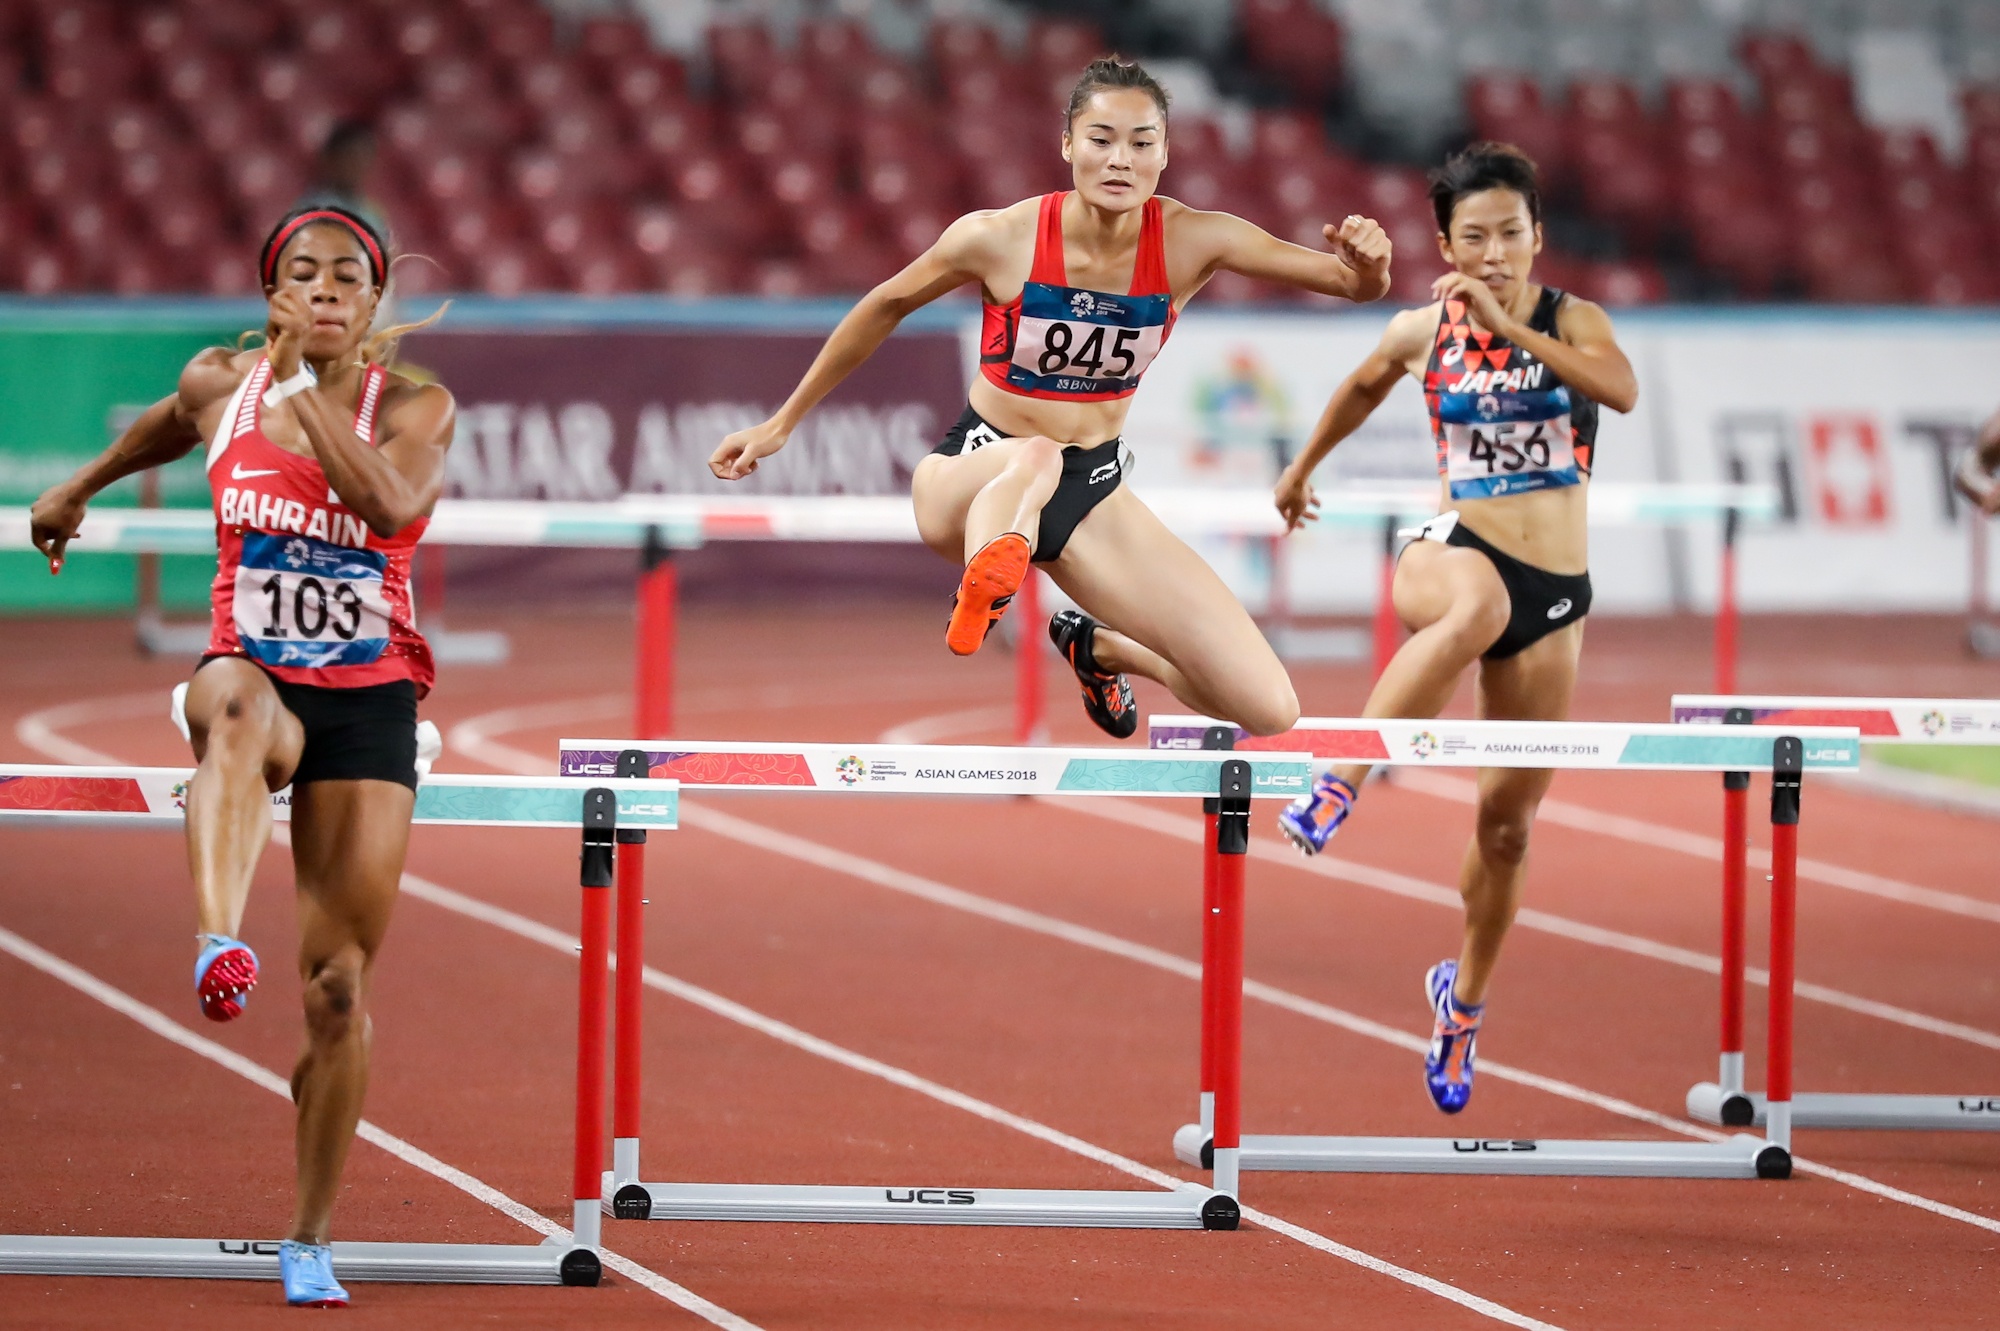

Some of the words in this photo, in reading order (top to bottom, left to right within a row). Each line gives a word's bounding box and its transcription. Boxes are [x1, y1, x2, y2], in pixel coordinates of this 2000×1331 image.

[1037, 322, 1141, 377] 845
[1070, 380, 1098, 391] BNI
[1448, 363, 1544, 394] JAPAN
[1469, 424, 1550, 473] 456
[220, 487, 369, 549] BAHRAIN
[261, 573, 363, 641] 103
[1157, 738, 1202, 749] UCS
[1485, 743, 1522, 753] ASIAN
[1525, 744, 1568, 754] GAMES
[1571, 745, 1599, 755] 2018
[1805, 748, 1851, 761] UCS
[567, 763, 616, 775] UCS
[915, 769, 956, 779] ASIAN
[958, 770, 1005, 780] GAMES
[1007, 771, 1037, 781] 2018
[1256, 775, 1304, 786] UCS
[617, 804, 670, 816] UCS
[1959, 1101, 2000, 1112] UC
[1453, 1141, 1537, 1152] UCS
[885, 1189, 975, 1204] UCS
[219, 1241, 281, 1255] UC
